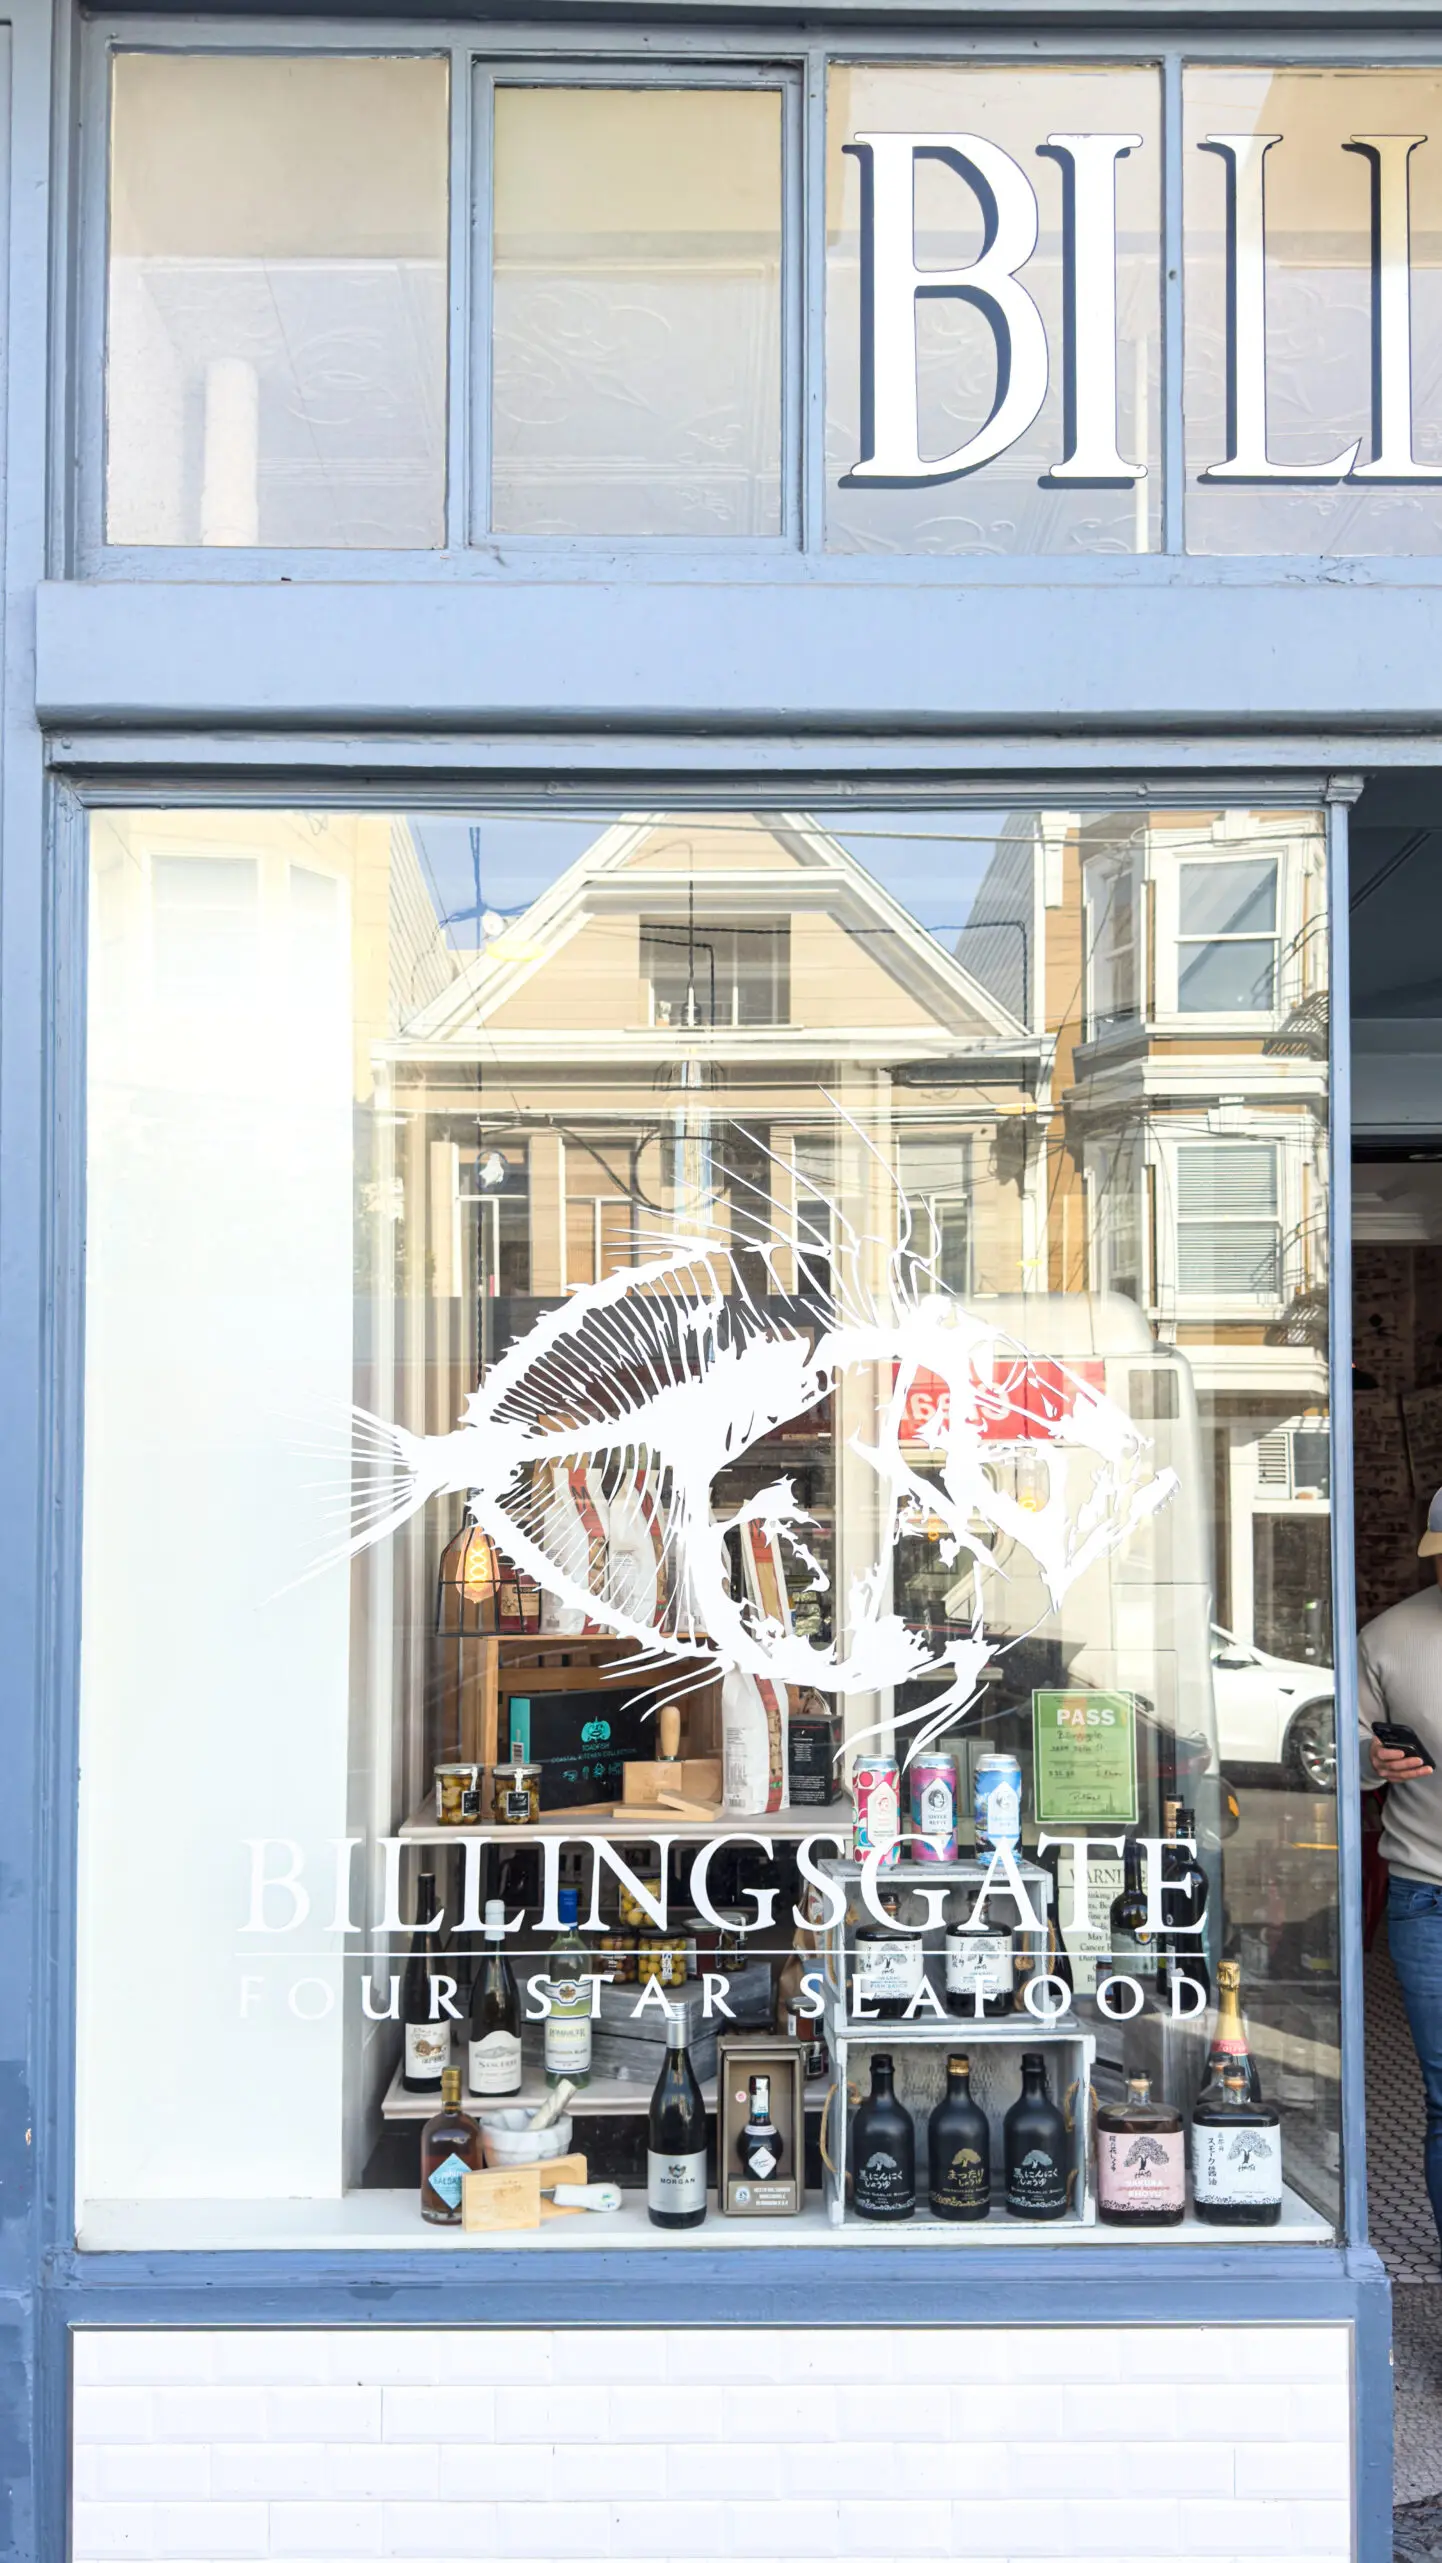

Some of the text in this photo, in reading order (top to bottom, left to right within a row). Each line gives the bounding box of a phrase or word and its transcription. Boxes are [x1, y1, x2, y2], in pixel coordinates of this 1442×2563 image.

[1056, 1708, 1116, 1726] PASS
[235, 1832, 1208, 1934] BILLINGSGATE
[1080, 1943, 1104, 1951] Cancer
[238, 1972, 1208, 2020] FOUR STAR SEAFOOD
[660, 2177, 695, 2185] MORGAN
